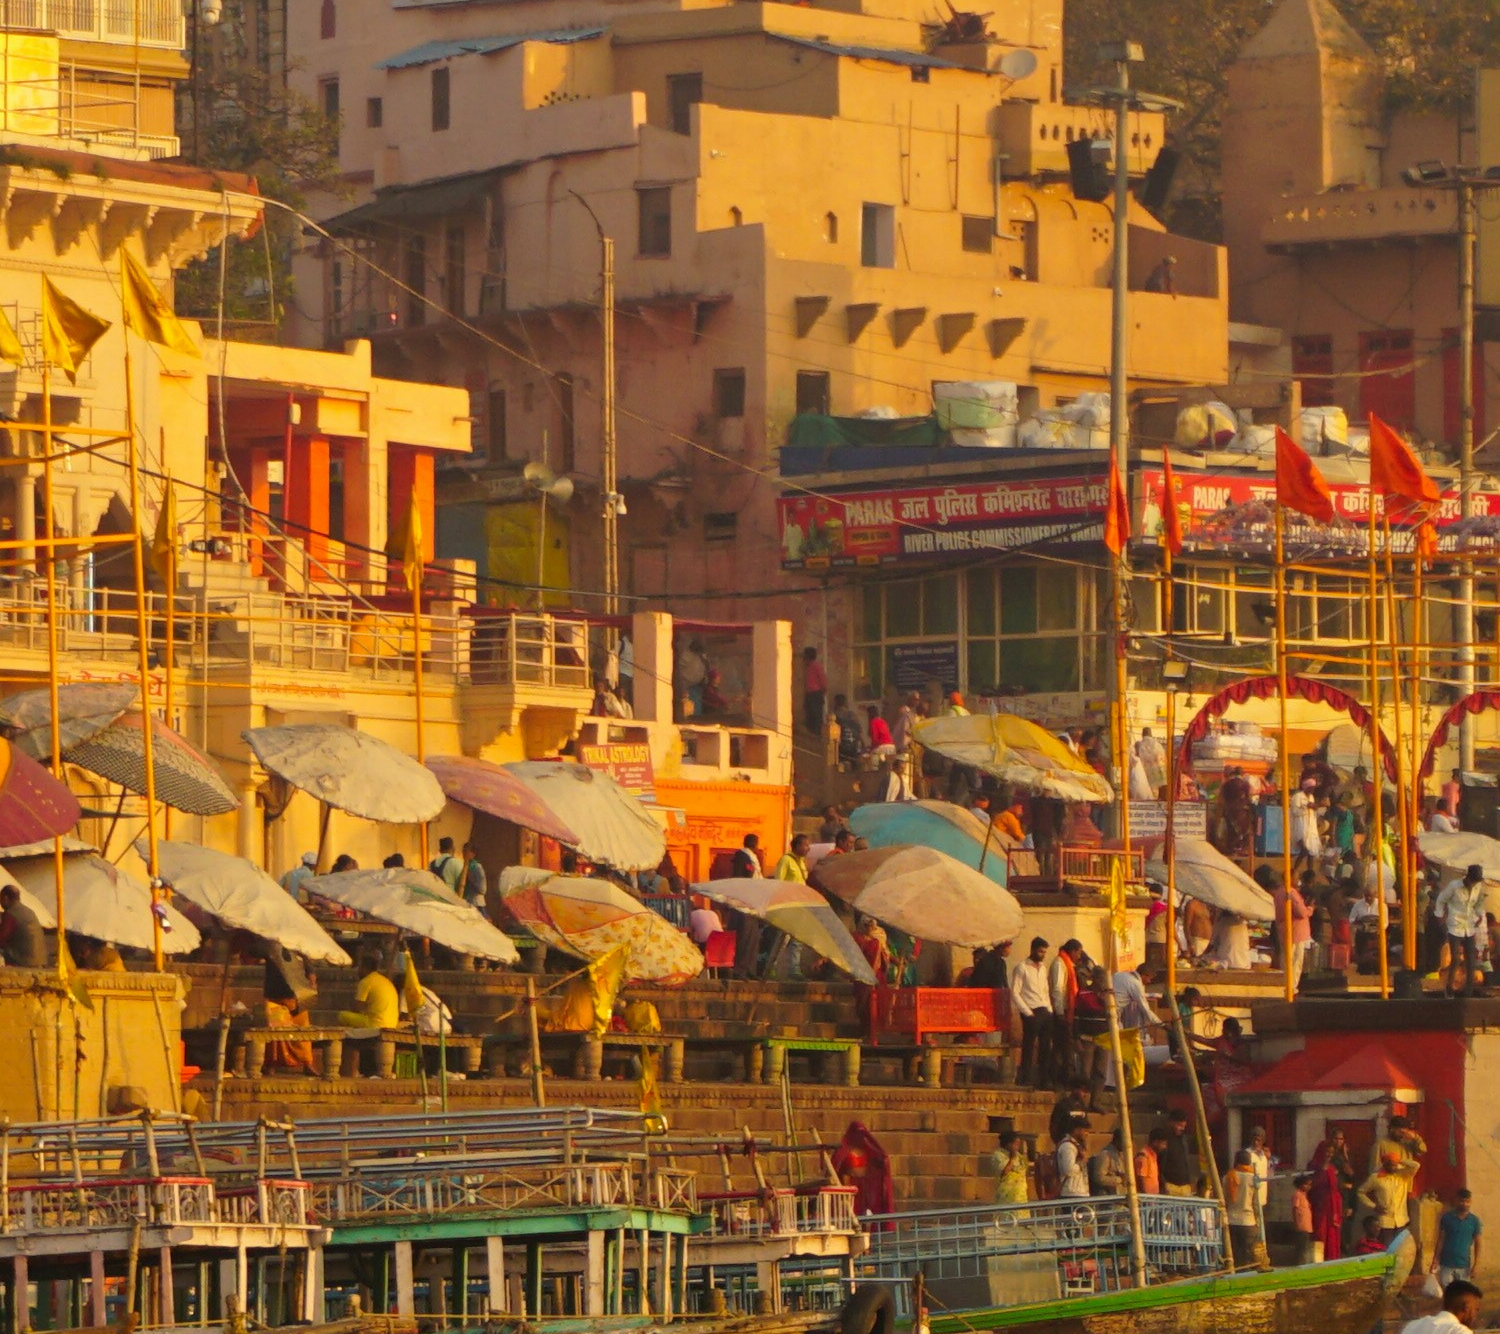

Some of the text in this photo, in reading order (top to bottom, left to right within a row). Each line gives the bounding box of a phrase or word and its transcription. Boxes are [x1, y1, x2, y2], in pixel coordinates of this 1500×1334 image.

[898, 496, 930, 521] जल
[933, 487, 979, 526] पुलिस
[904, 533, 935, 554] RIVER
